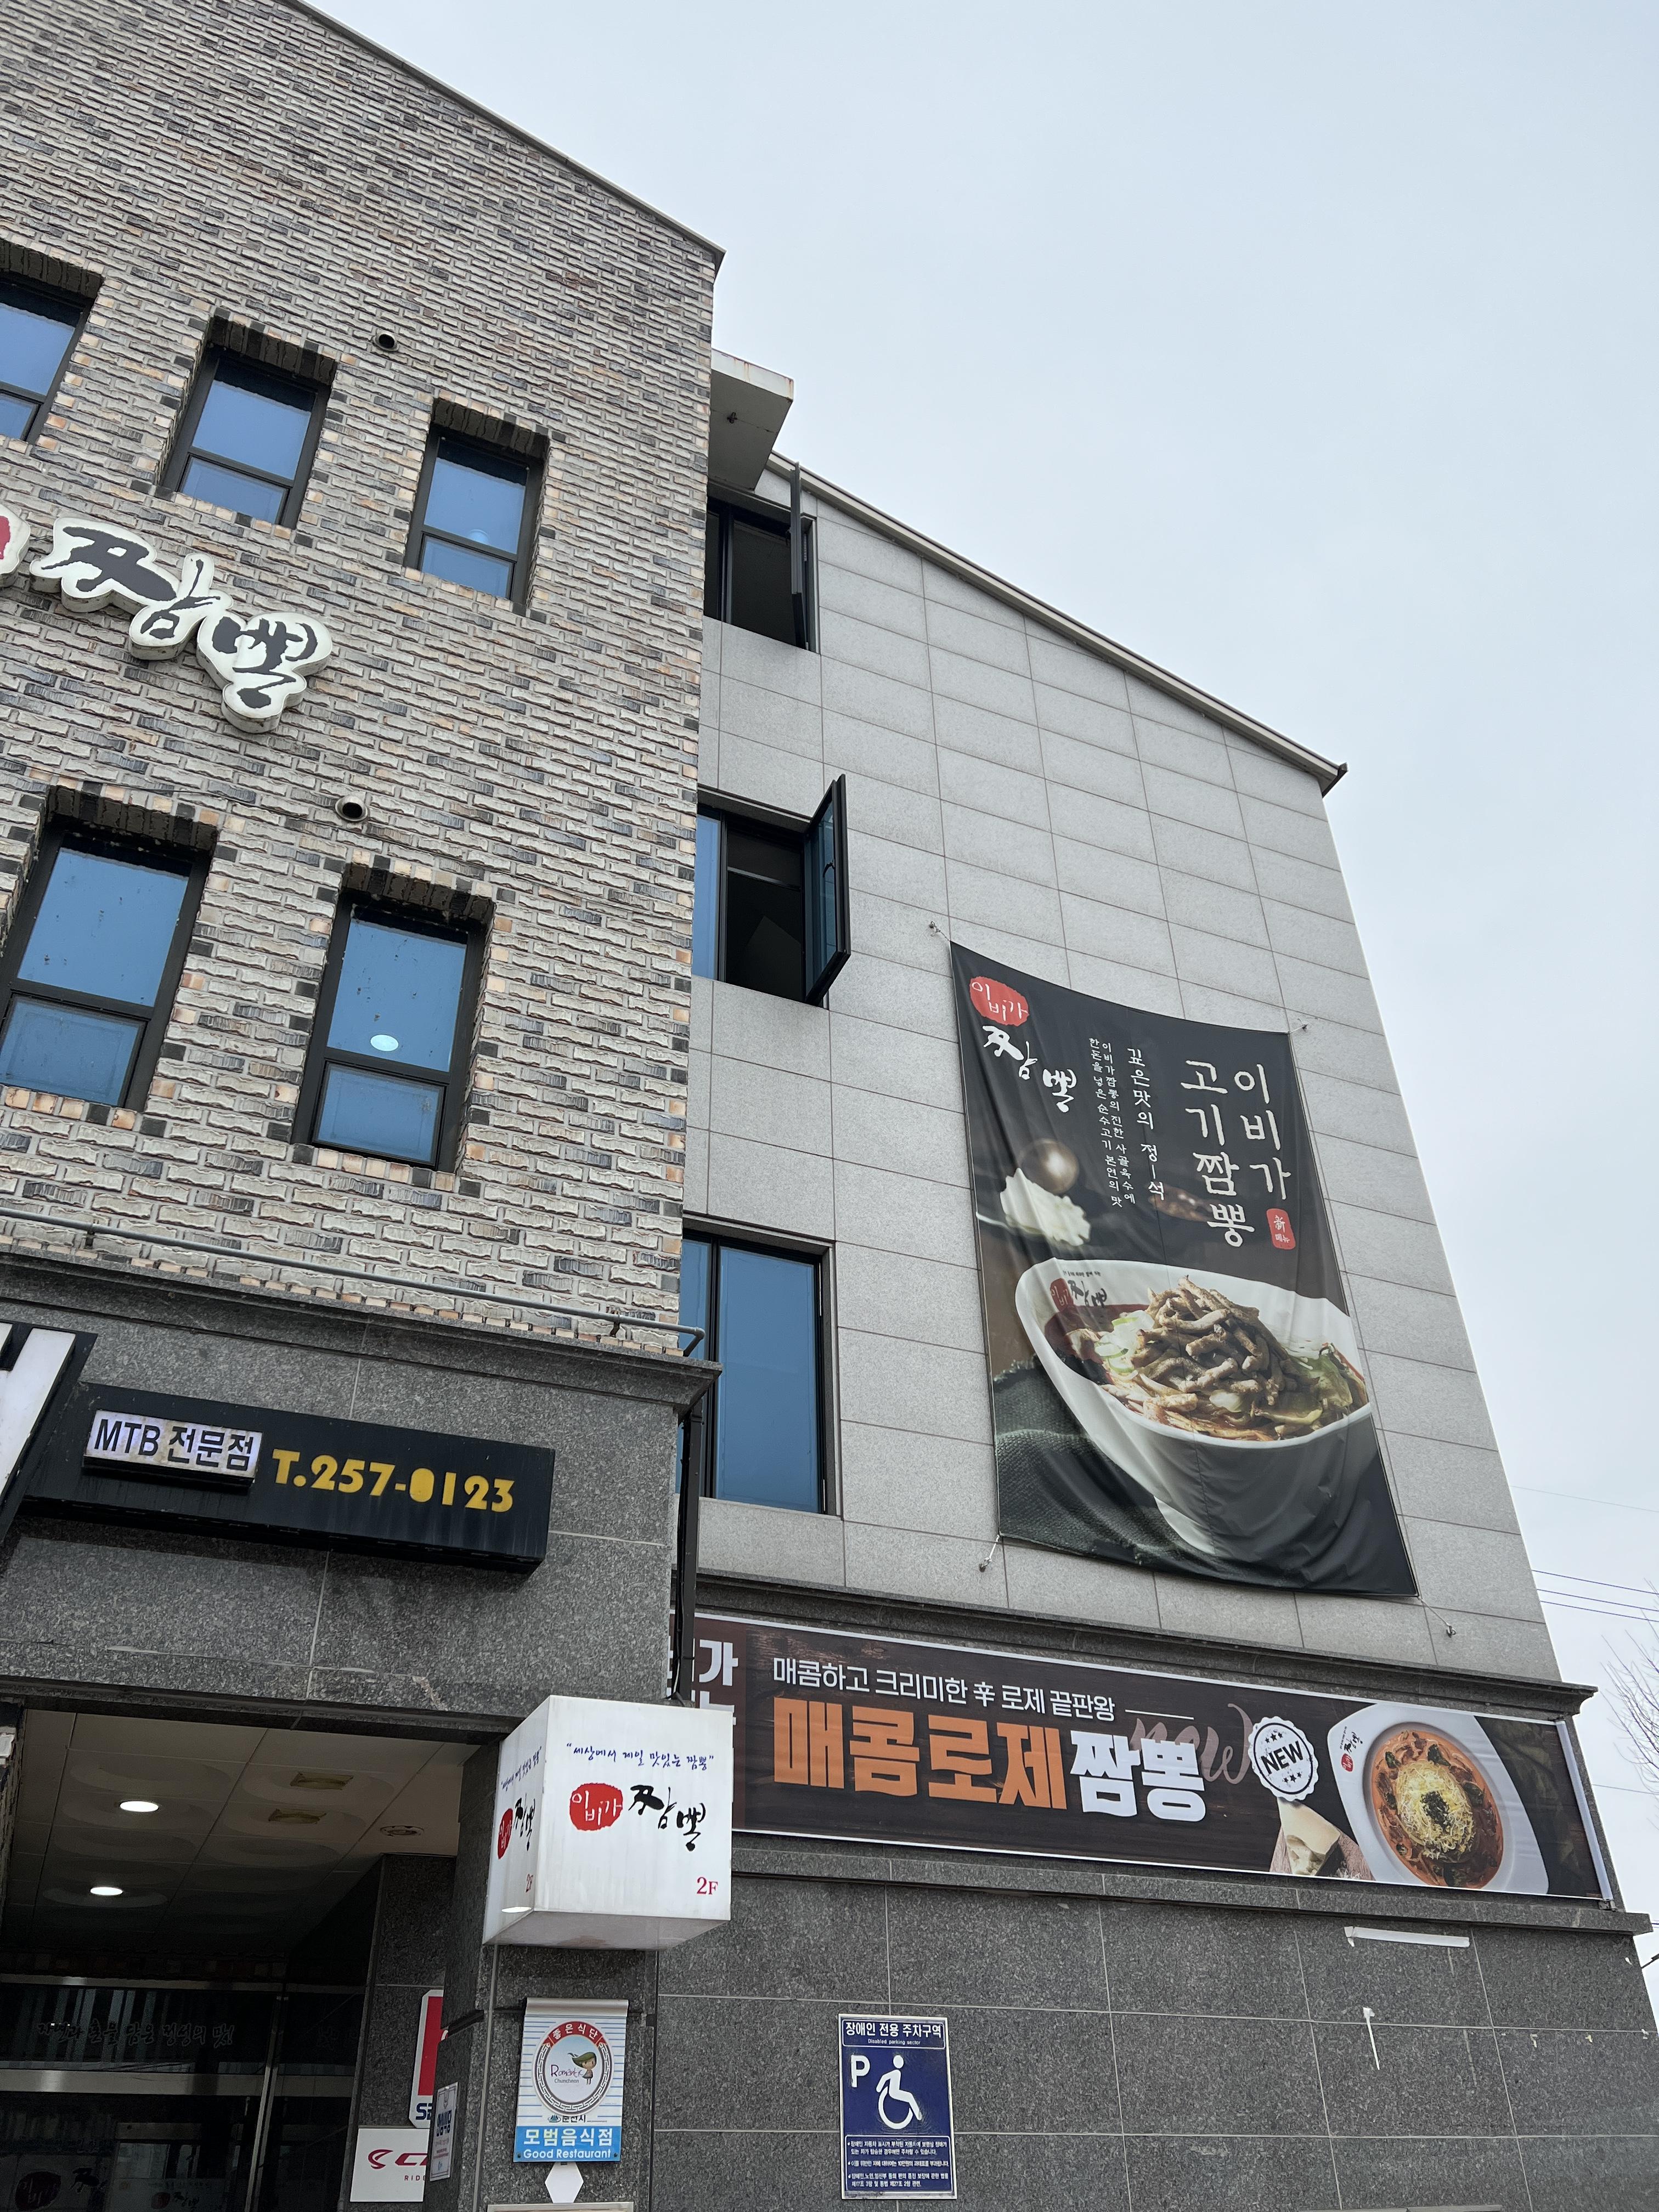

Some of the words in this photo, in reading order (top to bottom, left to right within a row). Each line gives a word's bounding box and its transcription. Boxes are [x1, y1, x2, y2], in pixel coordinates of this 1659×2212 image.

[971, 981, 1029, 1022] 이비가
[982, 1025, 1077, 1113] 짬뽕
[1110, 1115, 1124, 1139] 진한
[1234, 1063, 1291, 1200] 이비가
[1180, 1059, 1255, 1248] 고기짬뽕
[1104, 1154, 1119, 1192] 본연의
[1110, 1195, 1123, 1208] 맛
[94, 1419, 159, 1458] MTB
[167, 1426, 255, 1471] 전문점
[272, 1448, 515, 1513] T.257-0123
[773, 1657, 870, 1693] 매콤하고
[875, 1668, 968, 1705] 크리미한
[1001, 1684, 1046, 1714] 로제
[1049, 1689, 1115, 1722] 끝판왕
[622, 1750, 645, 1767] 제일
[650, 1751, 681, 1768] 맛있는
[1261, 1740, 1305, 1775] NEW
[571, 1790, 622, 1826] 이비가
[696, 1876, 719, 1895] 2F
[845, 2022, 876, 2036] 장애인
[879, 2023, 899, 2037] 전용
[902, 2024, 942, 2038] 주차구역
[851, 2055, 871, 2088] P
[523, 2128, 613, 2147] 모범음식점
[523, 2149, 555, 2159] Good
[556, 2148, 611, 2159] Restaurant
